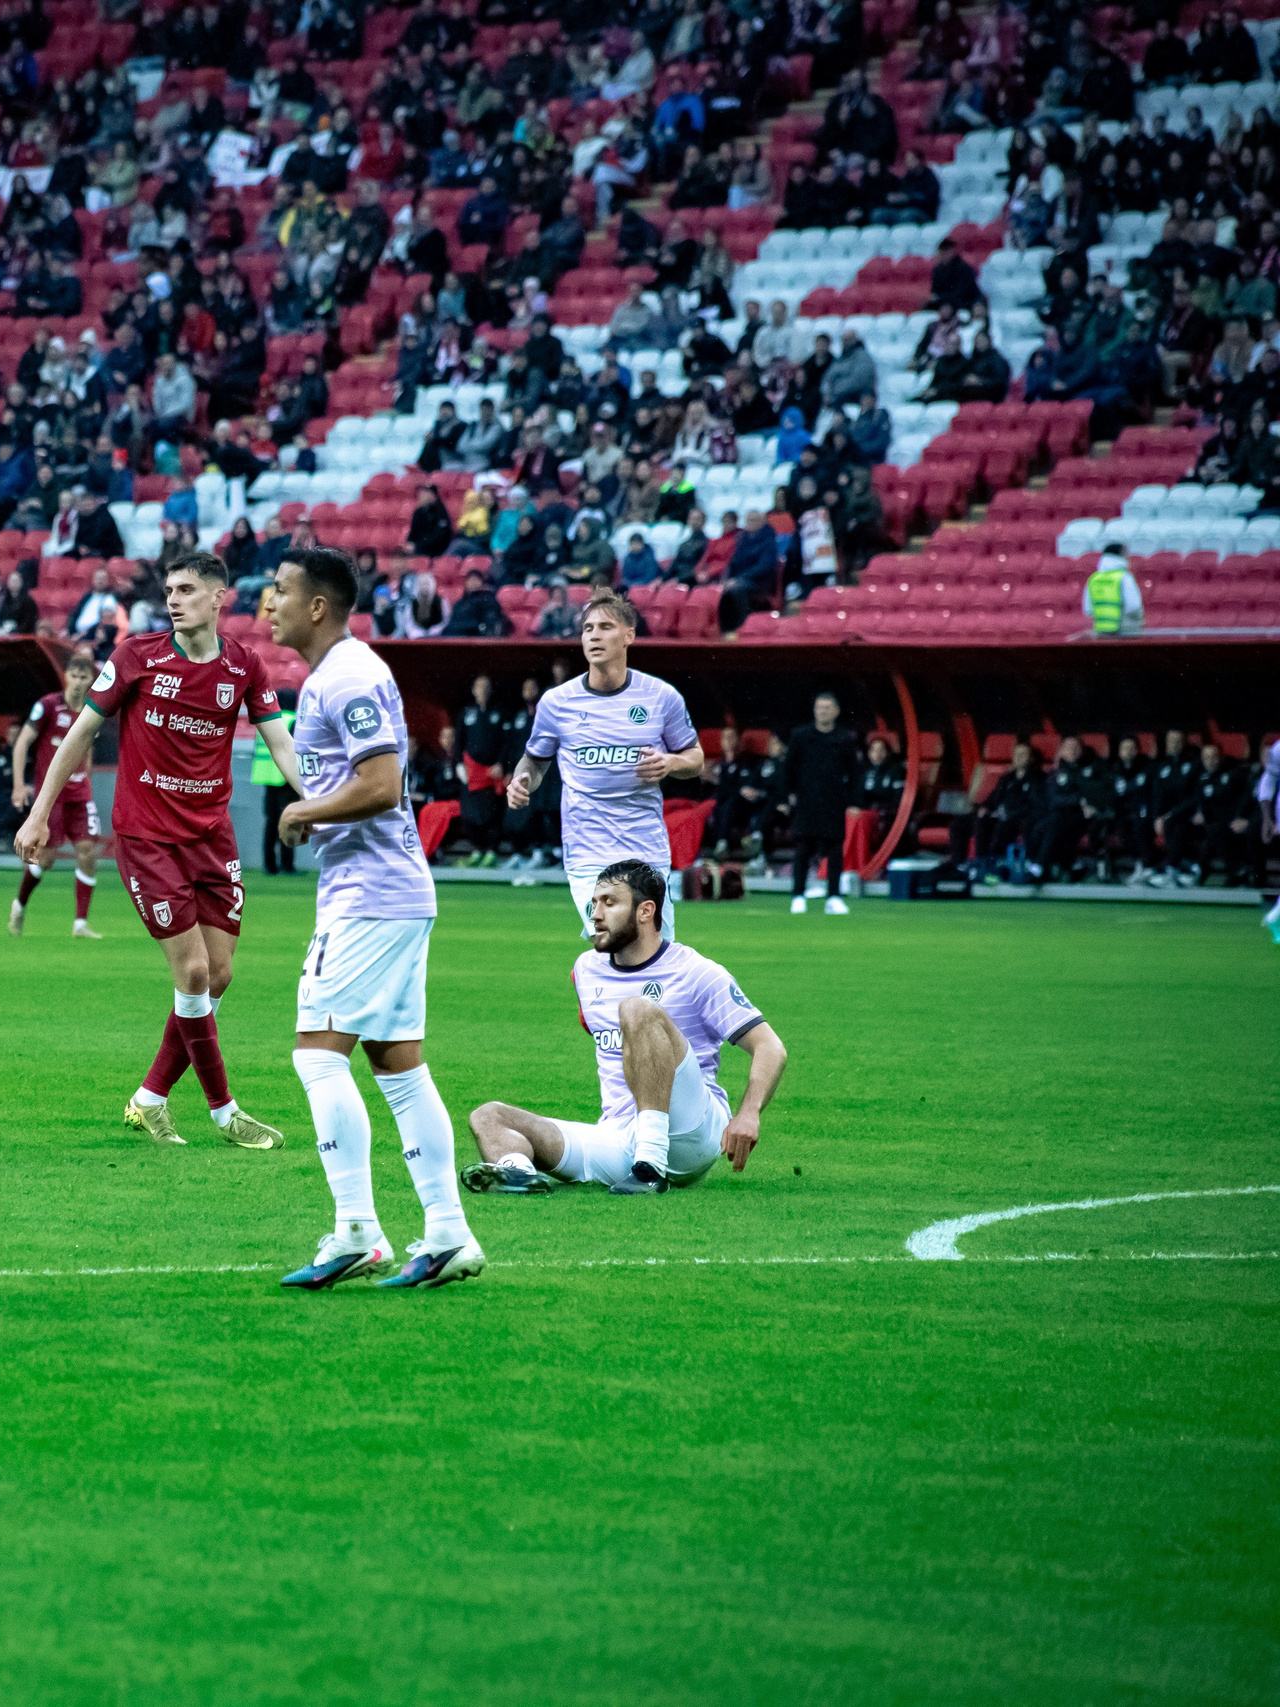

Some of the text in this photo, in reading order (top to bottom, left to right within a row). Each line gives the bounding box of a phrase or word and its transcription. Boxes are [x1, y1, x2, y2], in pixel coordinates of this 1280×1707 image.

[154, 673, 183, 688] FON
[151, 684, 181, 699] BET
[169, 713, 216, 729] КАЗАНЬ
[351, 719, 379, 734] LADA
[155, 780, 213, 794] НЕФТЕХИМ
[156, 773, 224, 787] НИЖНЕКАМСК
